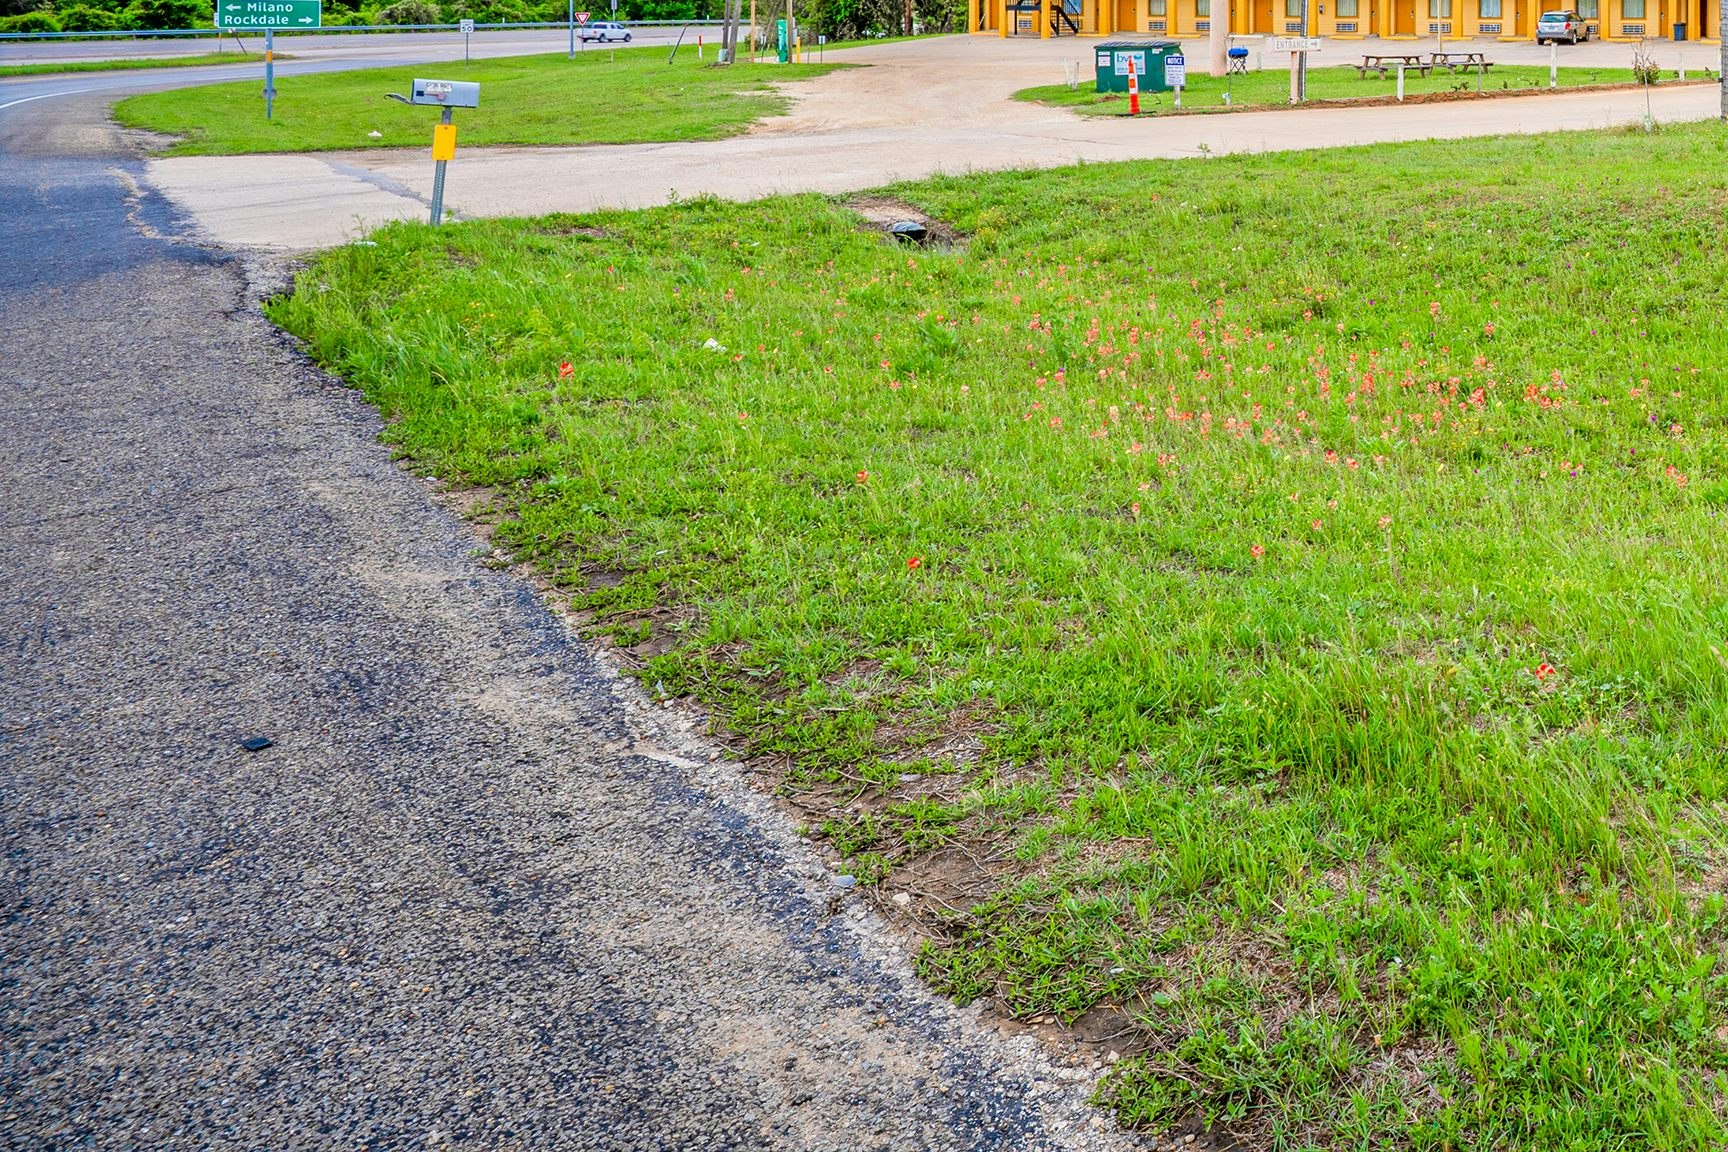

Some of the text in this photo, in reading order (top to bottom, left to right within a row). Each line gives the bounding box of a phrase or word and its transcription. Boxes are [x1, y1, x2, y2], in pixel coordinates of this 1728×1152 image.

[247, 2, 294, 12] Milano
[224, 14, 289, 25] Rockdale
[1276, 39, 1309, 49] ENTRANCE
[1167, 57, 1183, 65] NOTICE
